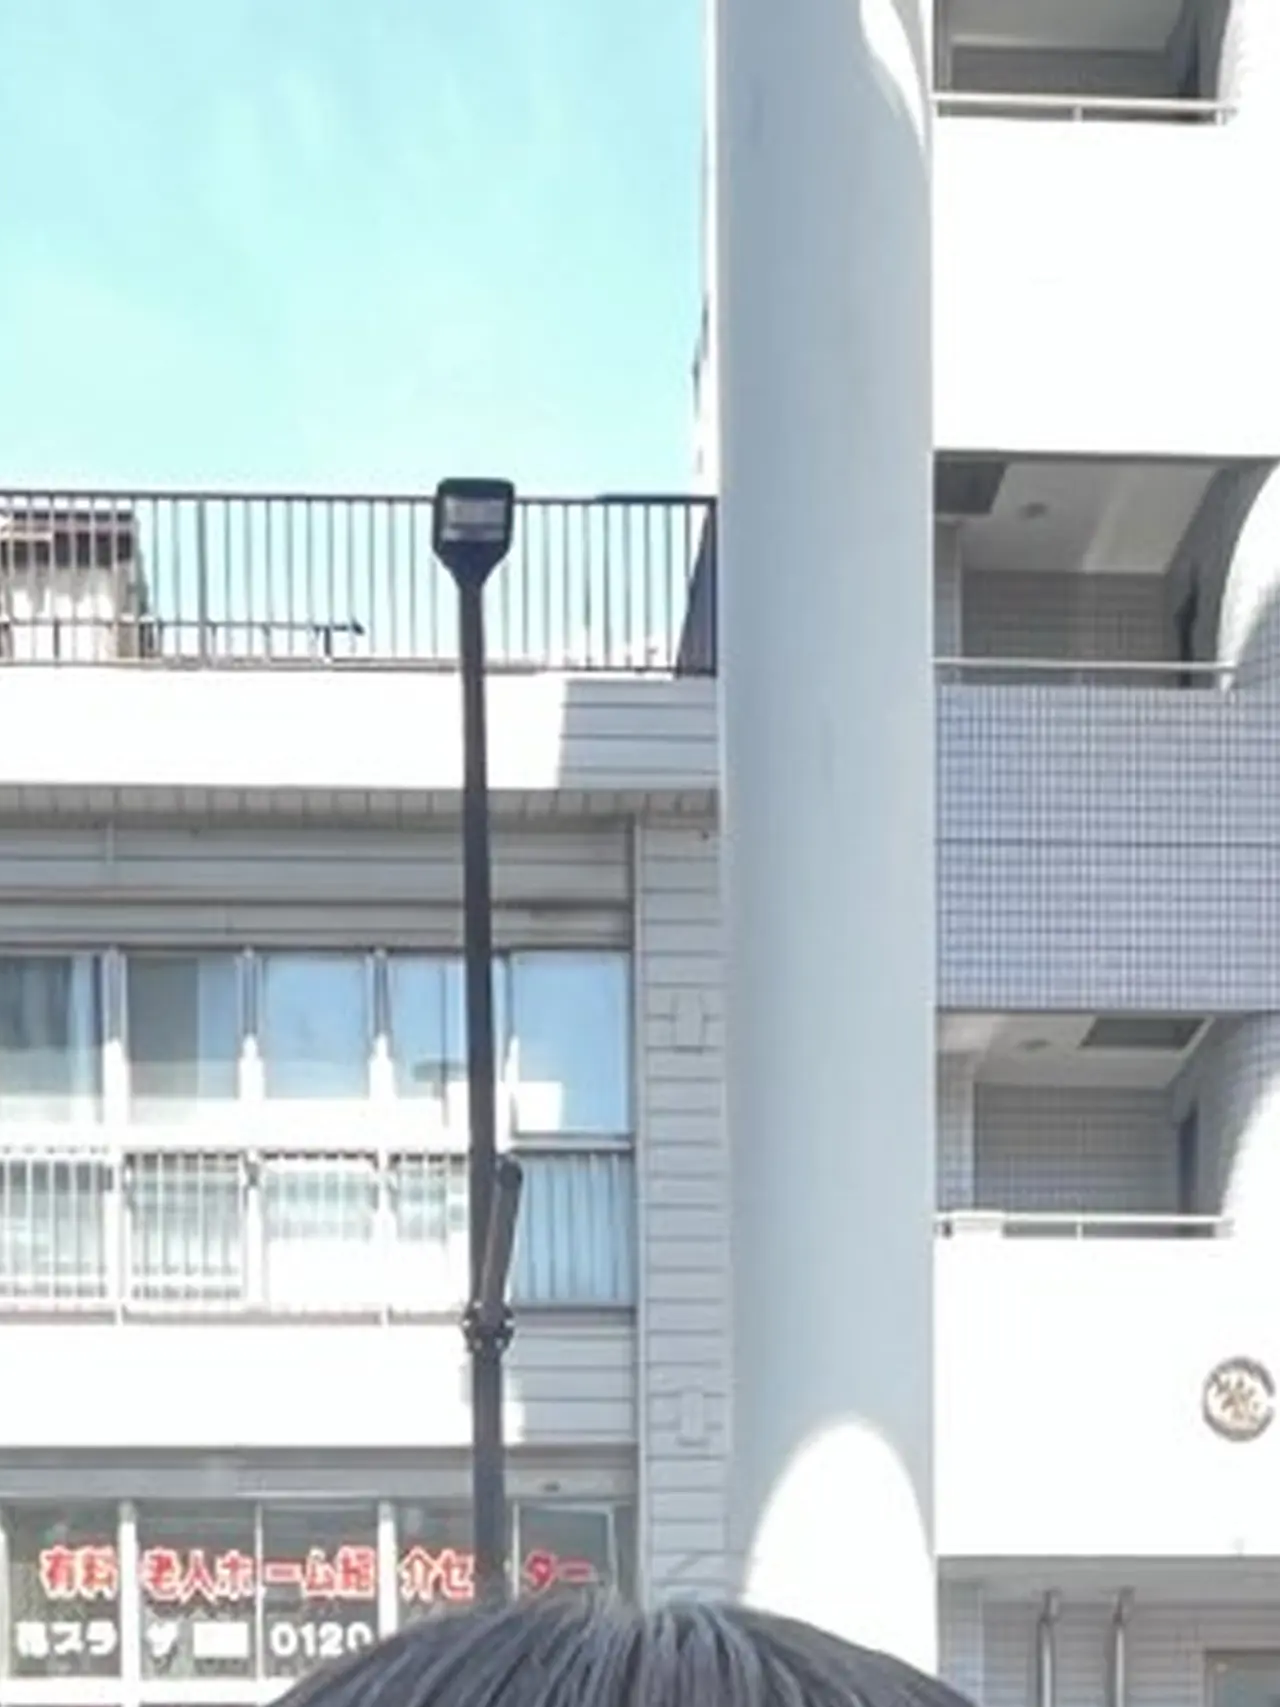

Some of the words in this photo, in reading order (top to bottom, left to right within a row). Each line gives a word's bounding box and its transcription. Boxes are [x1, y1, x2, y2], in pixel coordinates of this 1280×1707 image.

[39, 1544, 596, 1602] 有料老人ホーム紹介セター
